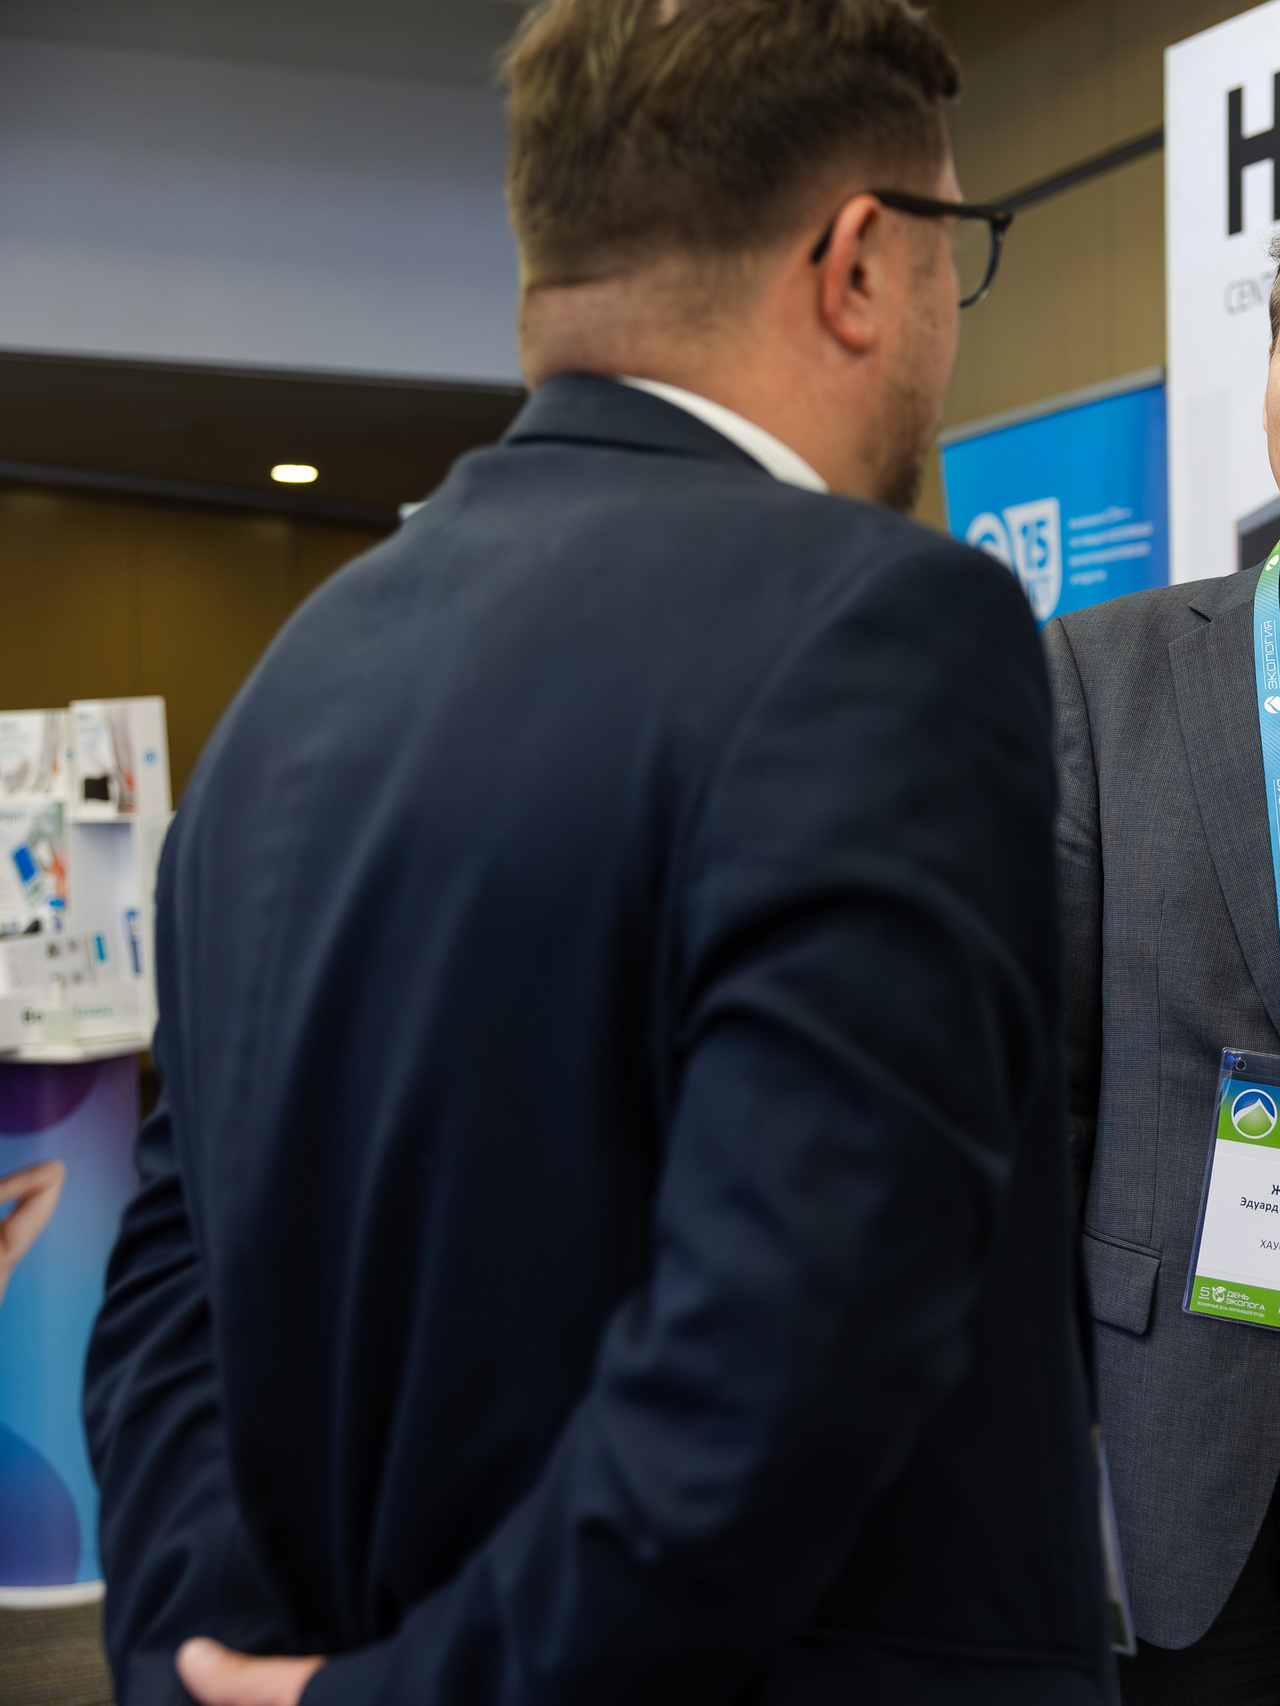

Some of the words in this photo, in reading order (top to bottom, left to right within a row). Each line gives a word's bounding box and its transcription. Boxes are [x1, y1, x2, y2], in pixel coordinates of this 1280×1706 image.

[1263, 620, 1278, 690] ЭКОЛОГИЯ
[1240, 1196, 1279, 1214] Эдуард
[1226, 1290, 1250, 1300] ДЕНЬ
[1225, 1298, 1265, 1311] ЭКОЛОГА
